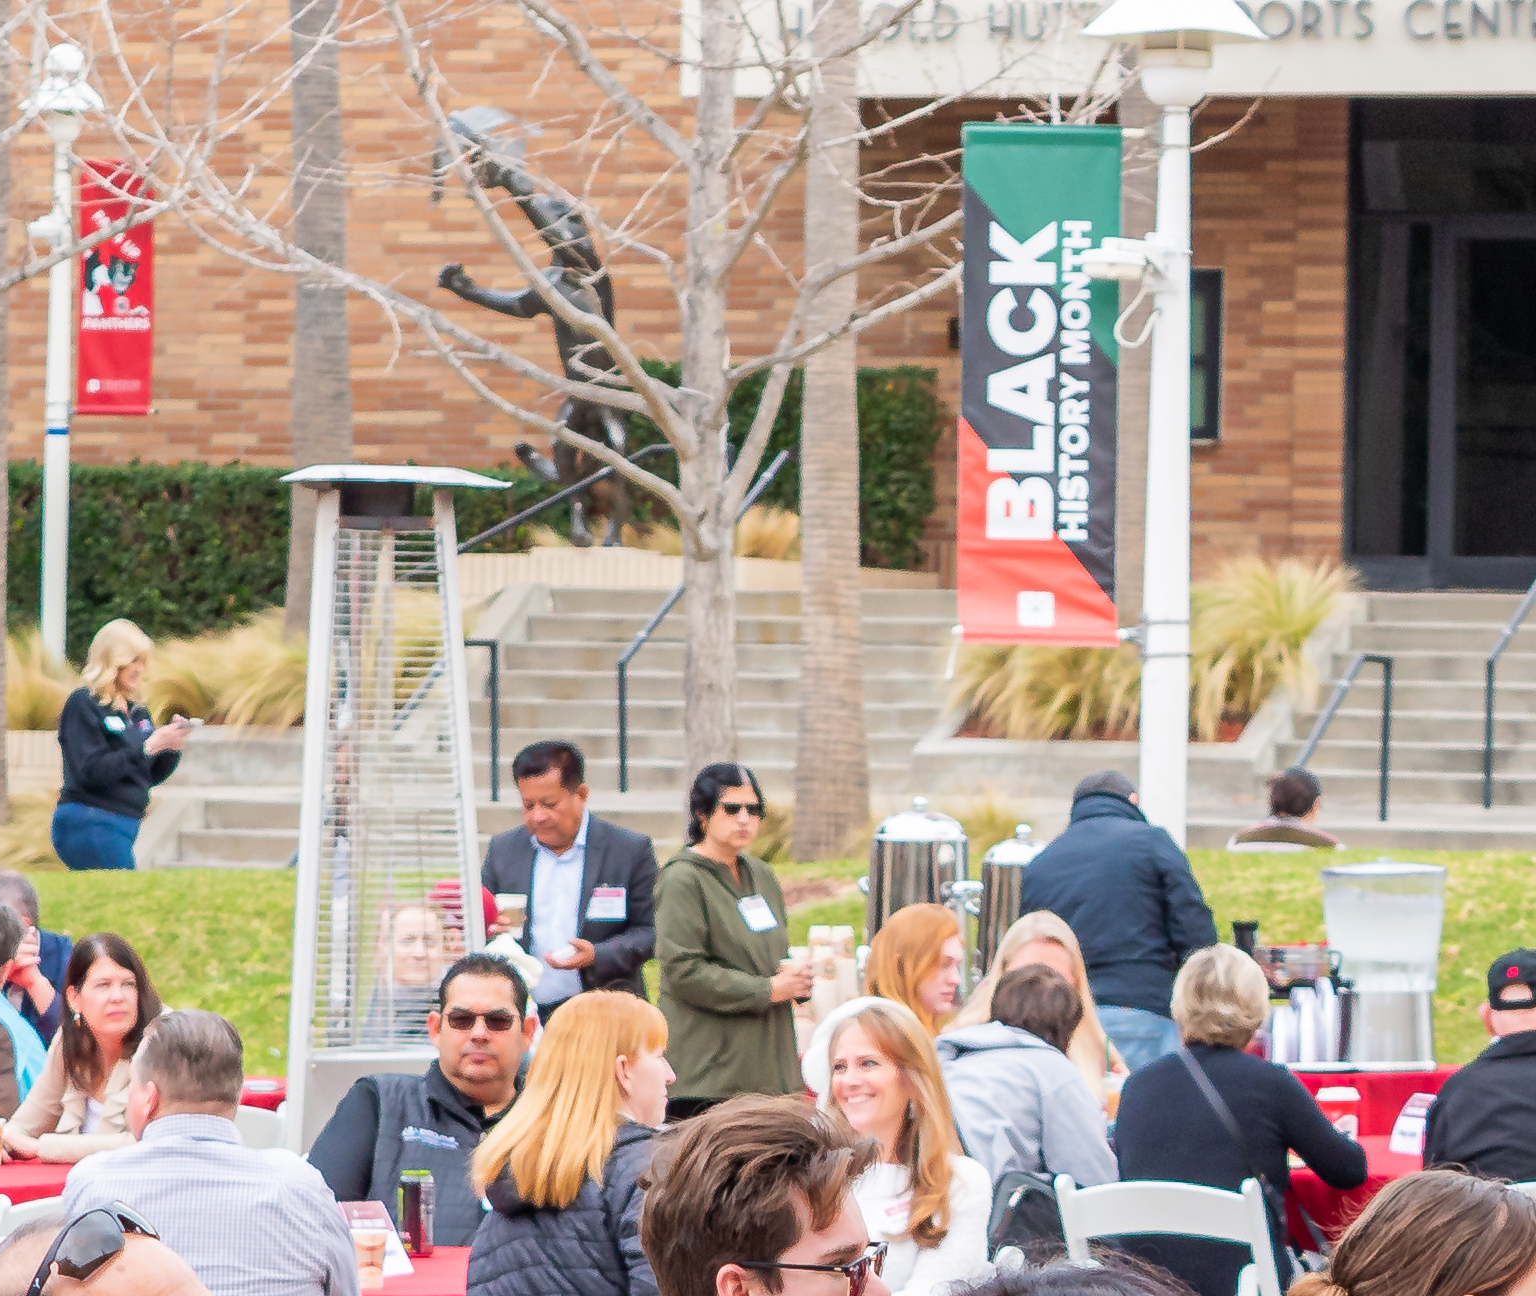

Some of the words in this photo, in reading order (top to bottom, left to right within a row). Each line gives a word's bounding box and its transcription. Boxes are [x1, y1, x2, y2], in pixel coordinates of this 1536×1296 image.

[1059, 220, 1093, 365] MONTH
[985, 220, 1057, 540] BLACK
[1057, 371, 1091, 543] HISTORY
